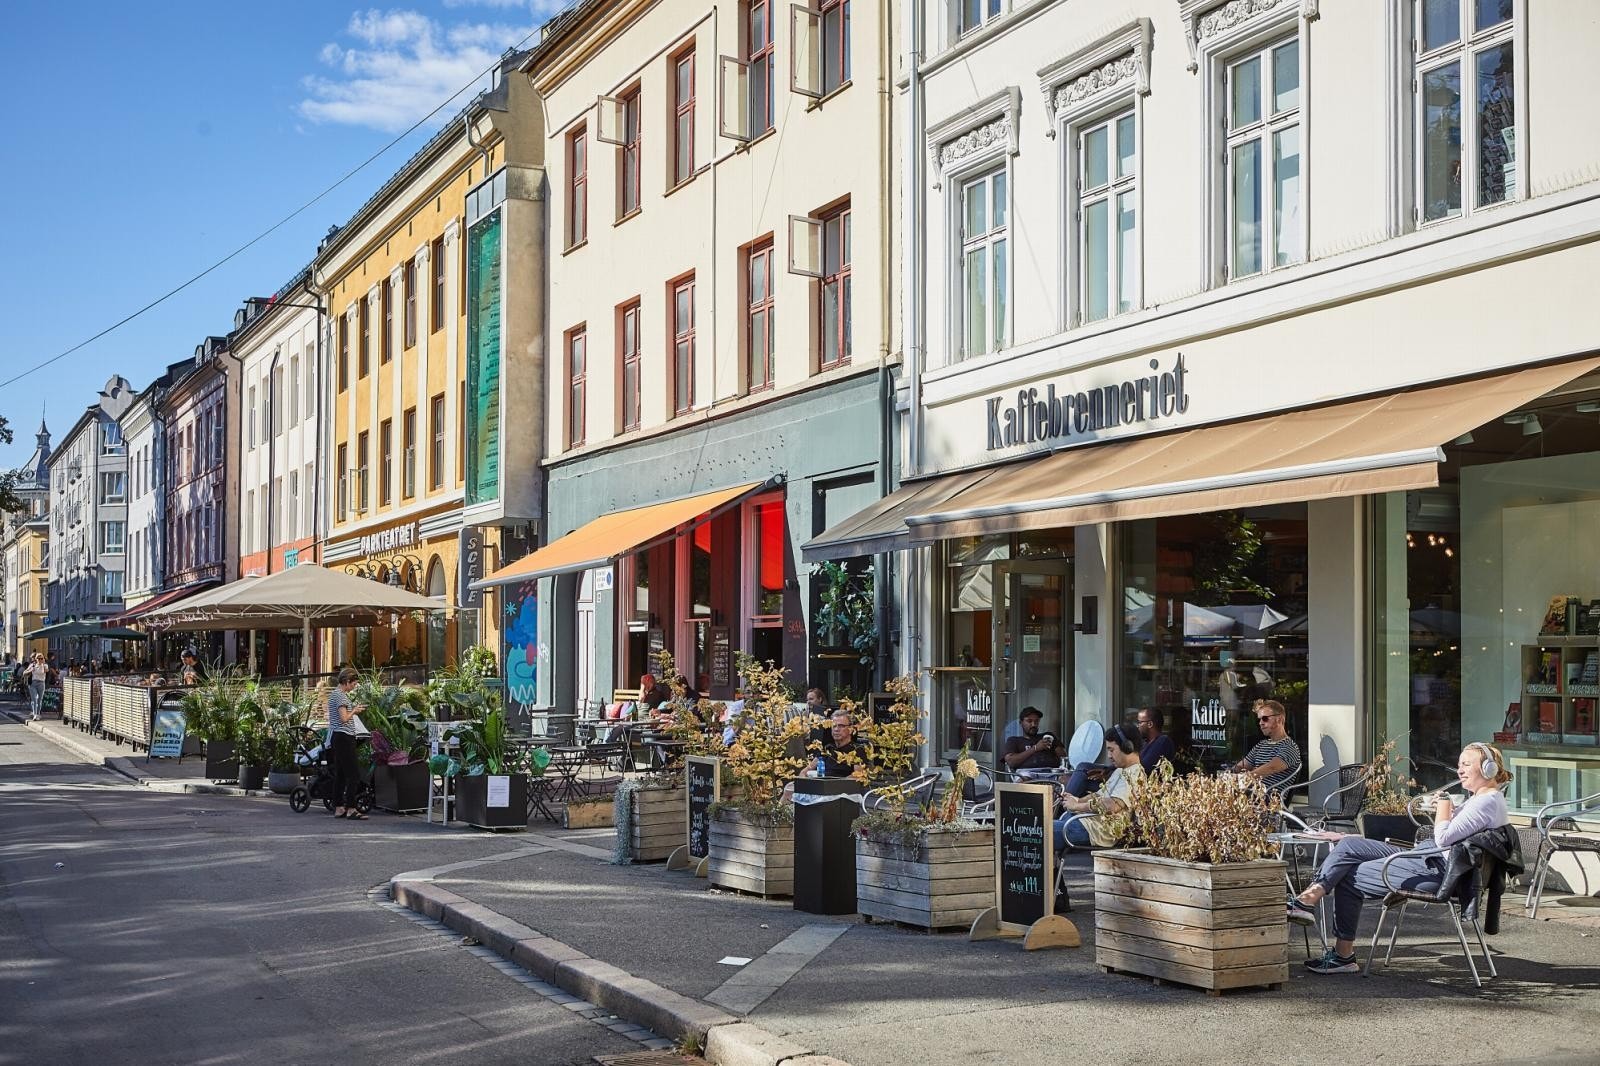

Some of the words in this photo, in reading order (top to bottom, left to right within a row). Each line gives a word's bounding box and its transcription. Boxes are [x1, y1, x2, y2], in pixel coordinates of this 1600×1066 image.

[986, 352, 1190, 450] Kaffebrenneriet
[360, 522, 416, 556] PARKTEATRET
[966, 689, 991, 712] Kaffe
[1191, 698, 1227, 726] Kaffe
[1191, 725, 1227, 741] brenneriet
